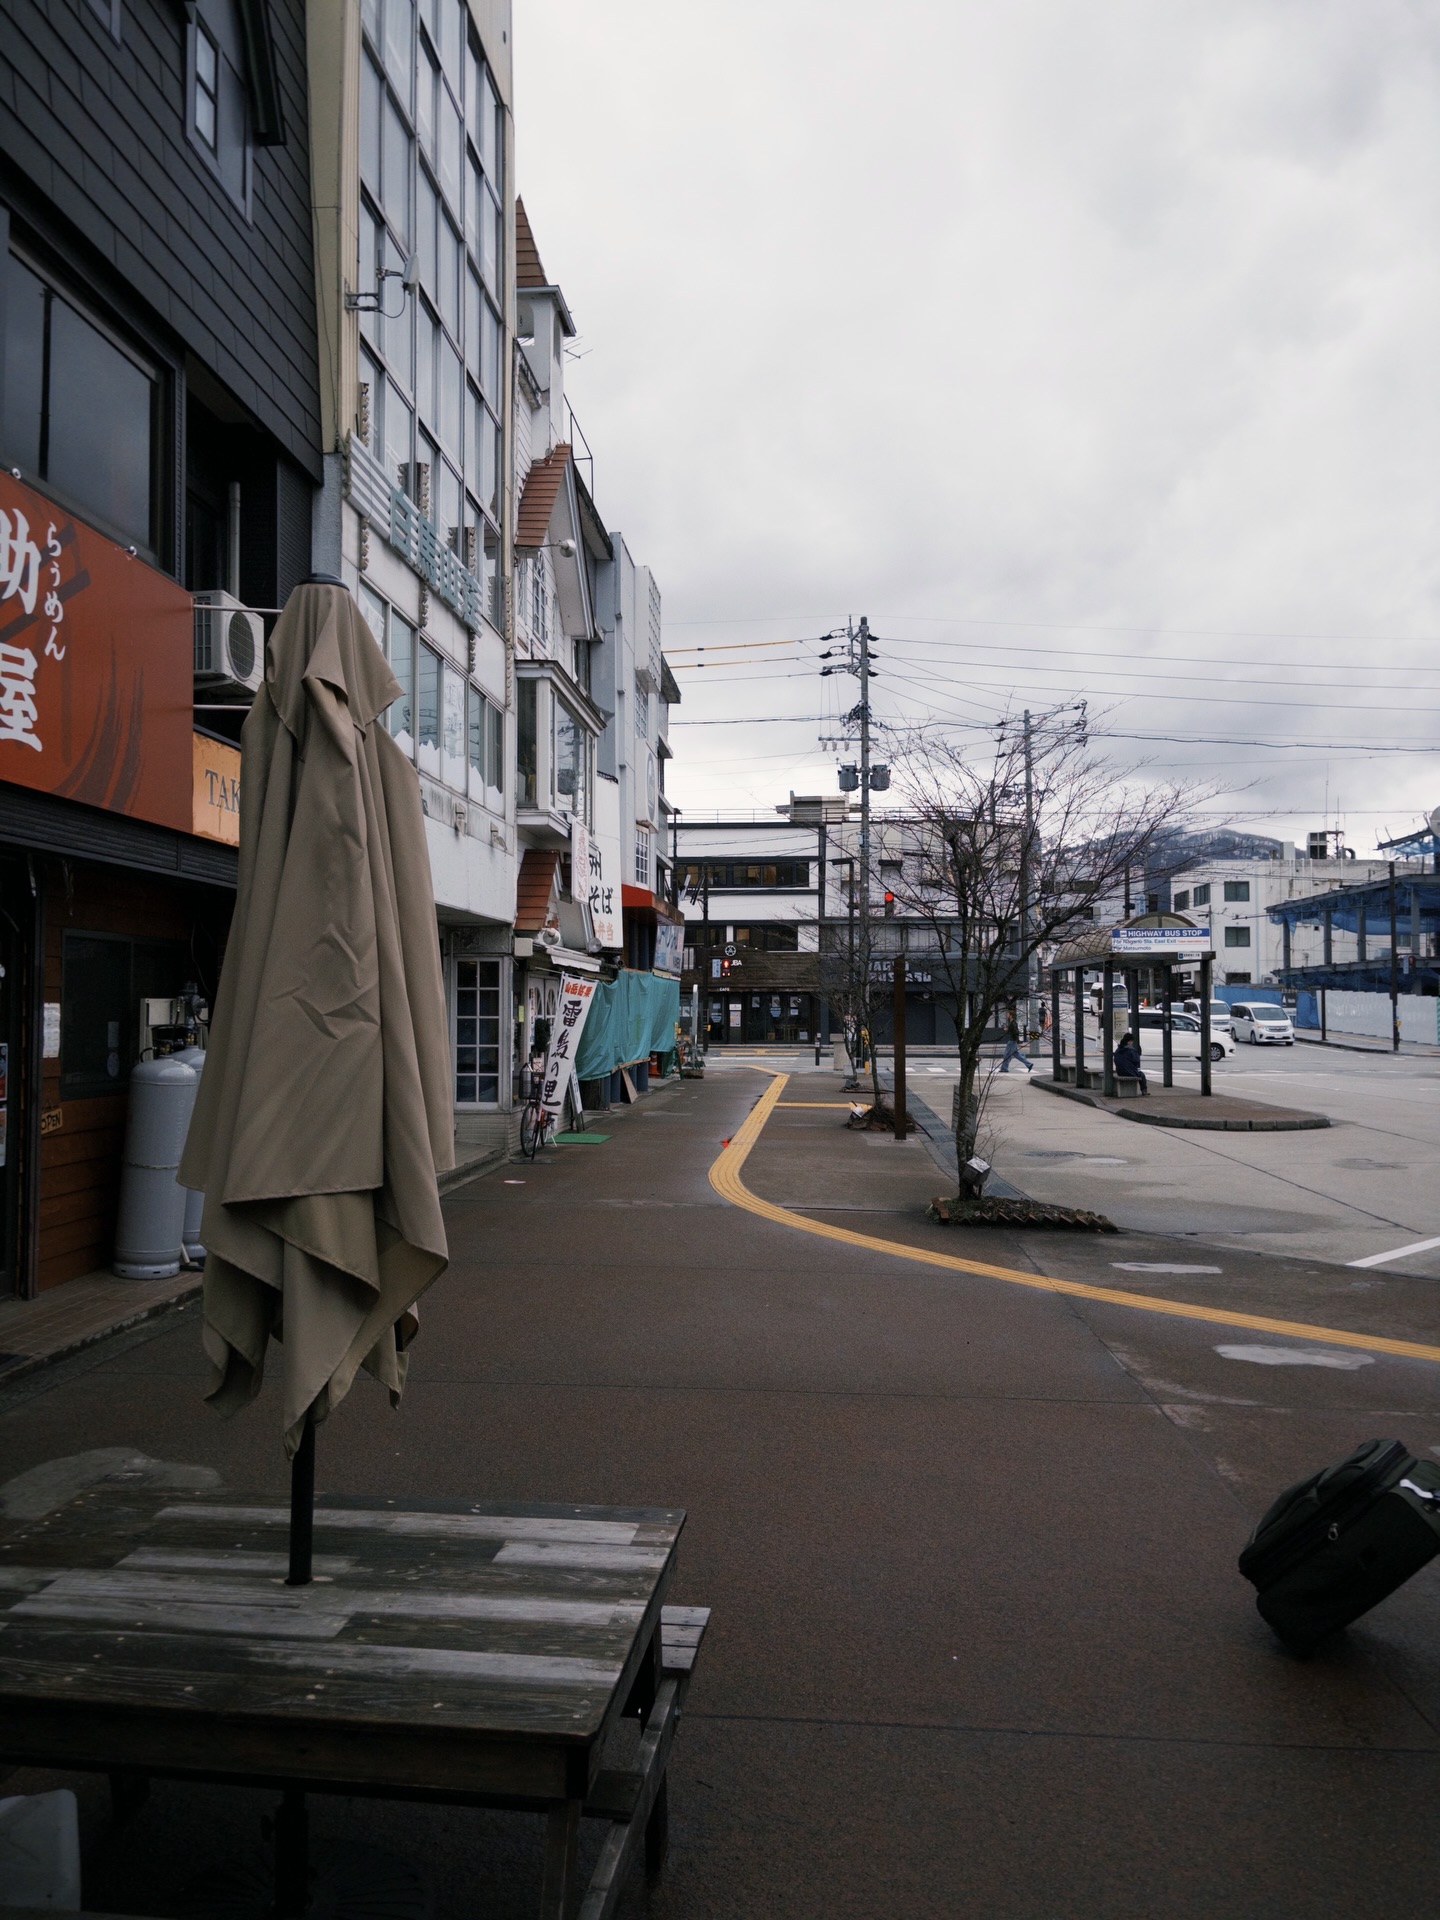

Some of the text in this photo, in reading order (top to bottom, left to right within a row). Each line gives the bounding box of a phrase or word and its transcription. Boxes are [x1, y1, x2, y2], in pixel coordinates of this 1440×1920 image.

[588, 885, 615, 915] そば
[593, 918, 615, 942] 弁当
[541, 998, 583, 1108] 雷鳥の里
[41, 1112, 61, 1130] OPEN
